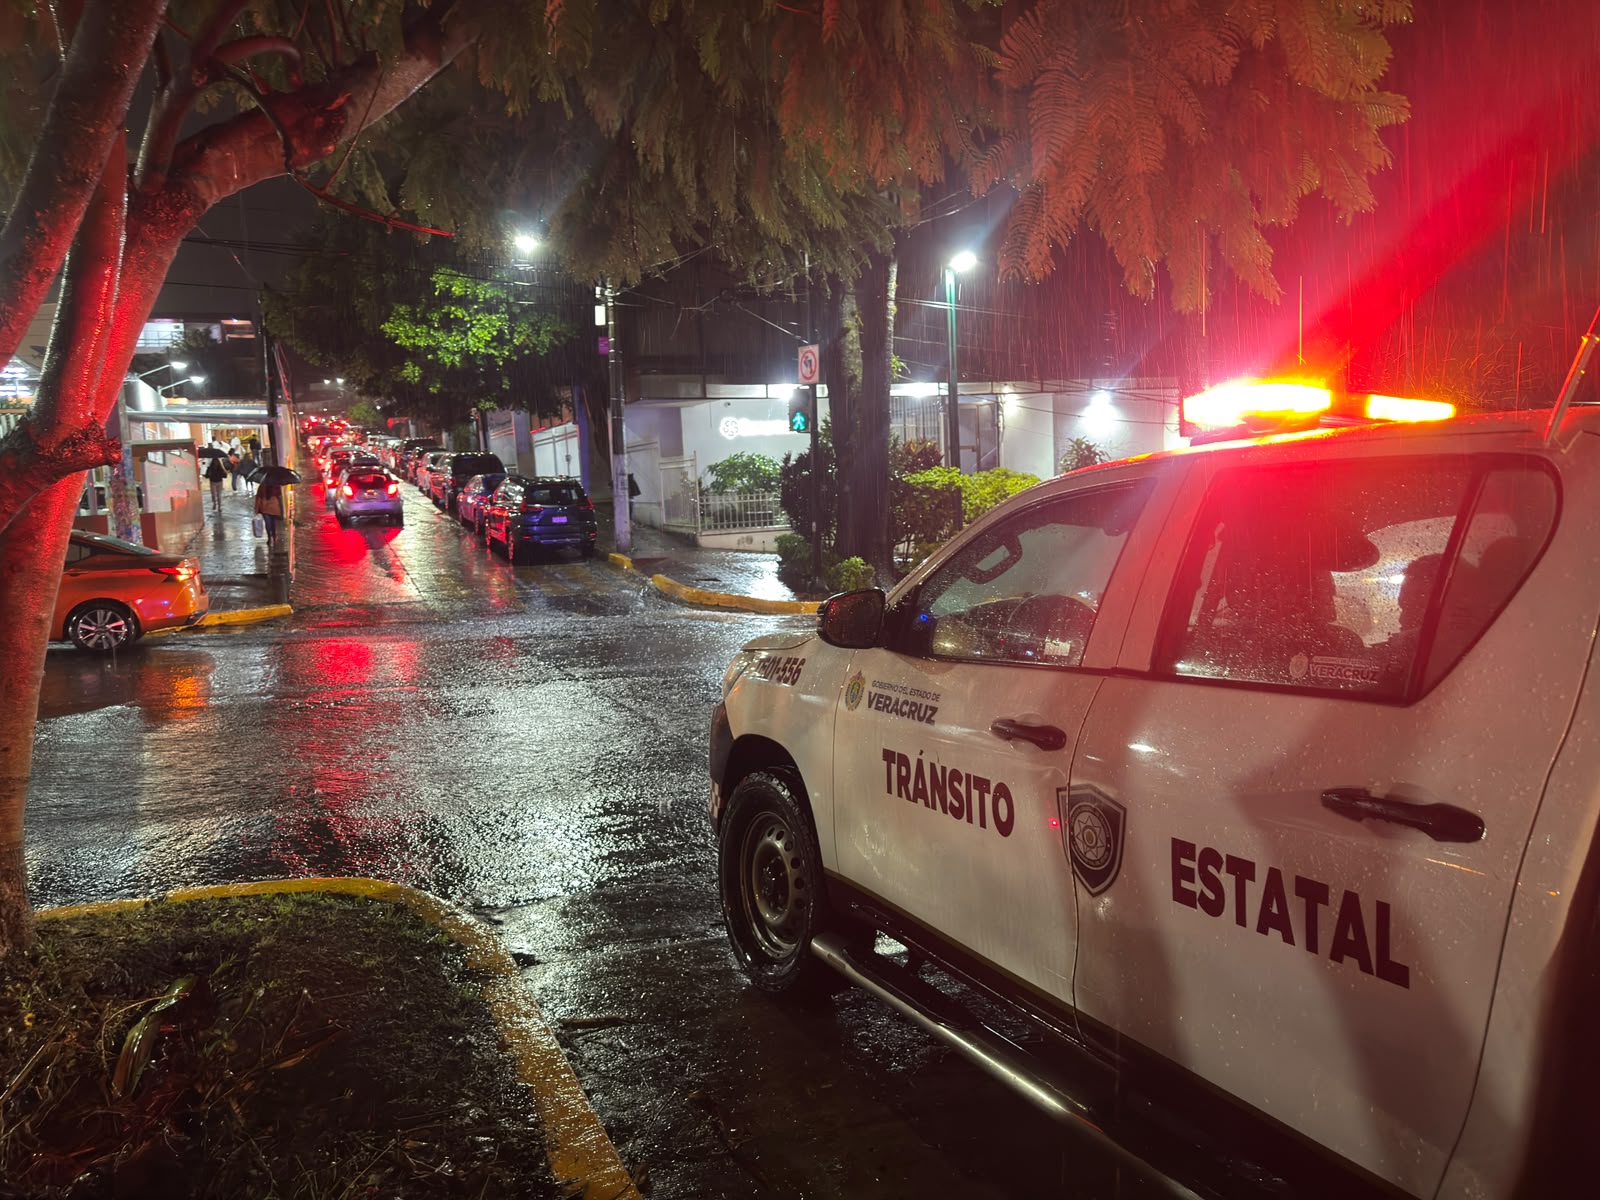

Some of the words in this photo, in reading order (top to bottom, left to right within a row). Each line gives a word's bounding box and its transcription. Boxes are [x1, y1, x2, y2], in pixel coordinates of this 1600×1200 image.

[868, 691, 939, 725] VERACRUZ
[872, 680, 898, 692] GOBIERNO
[899, 686, 909, 695] DEL
[909, 688, 931, 700] ESTADO
[931, 692, 941, 702] DE
[882, 748, 1015, 838] TRÁNSITO
[1171, 837, 1410, 990] ESTATAL
